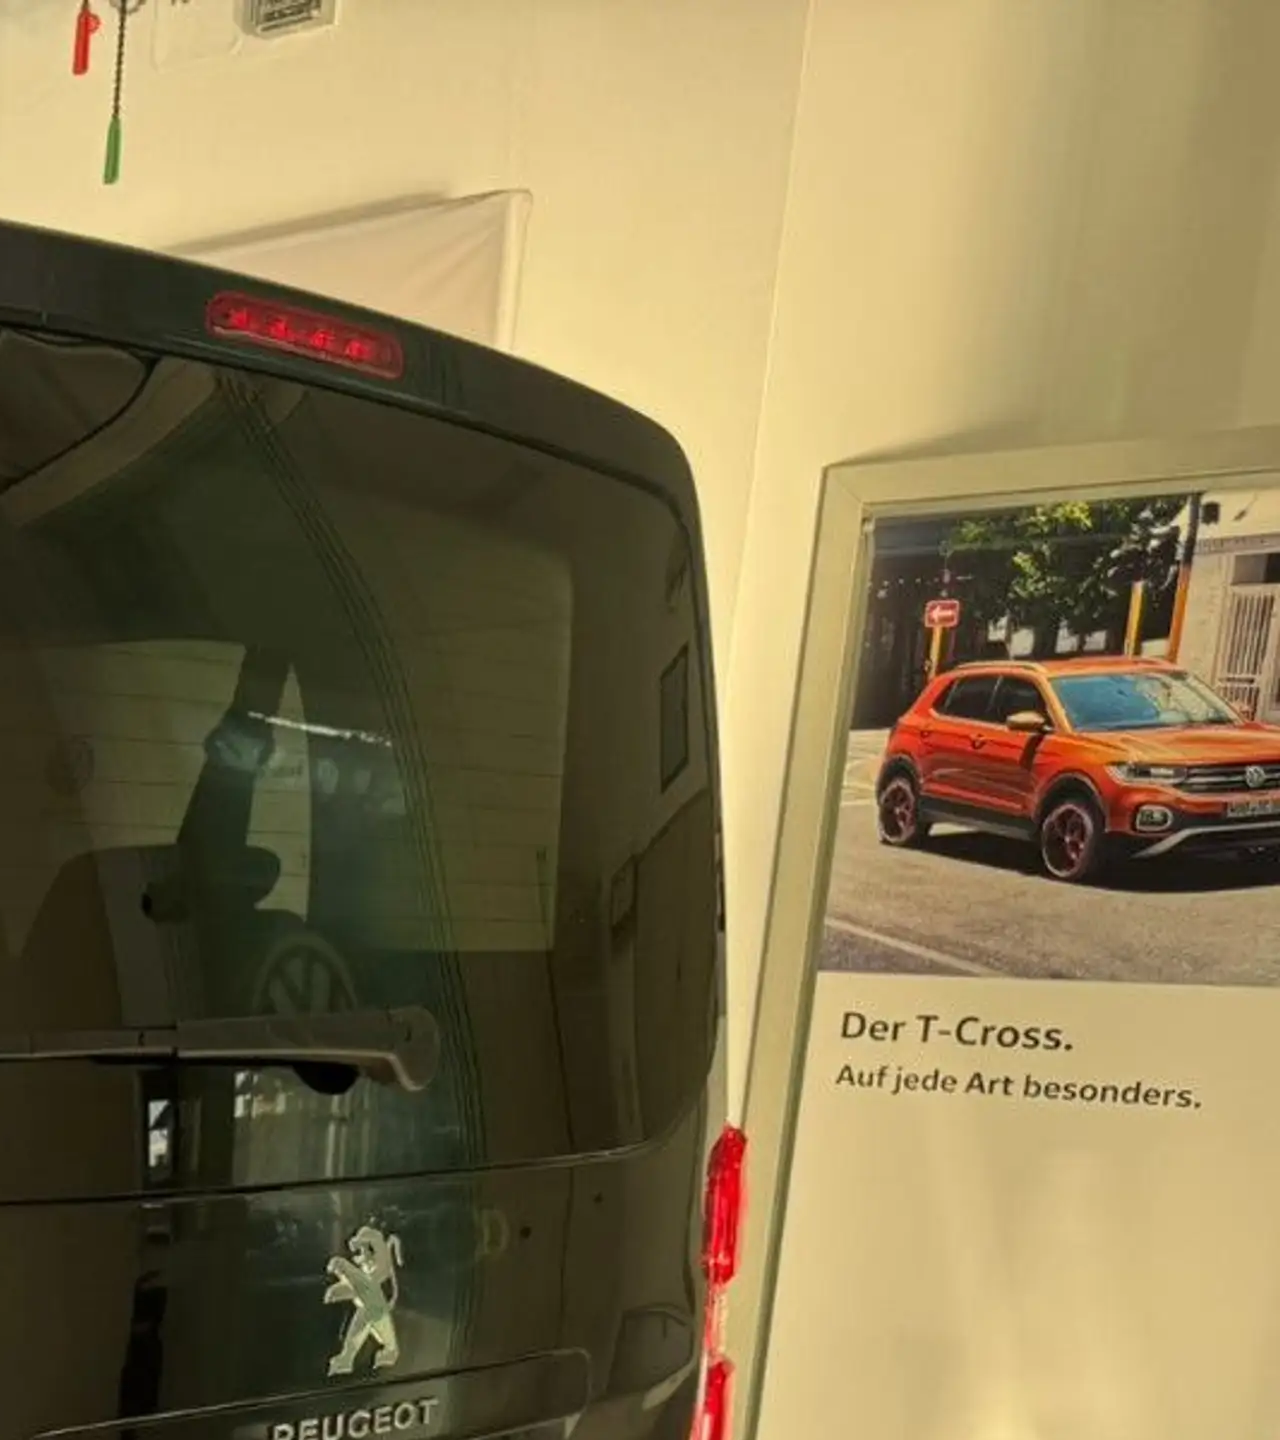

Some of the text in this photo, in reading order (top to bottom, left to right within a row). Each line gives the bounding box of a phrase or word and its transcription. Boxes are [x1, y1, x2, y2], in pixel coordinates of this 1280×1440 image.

[841, 1012, 1073, 1051] Der T-Cross.
[836, 1064, 1202, 1110] Auf jede Art besonders.
